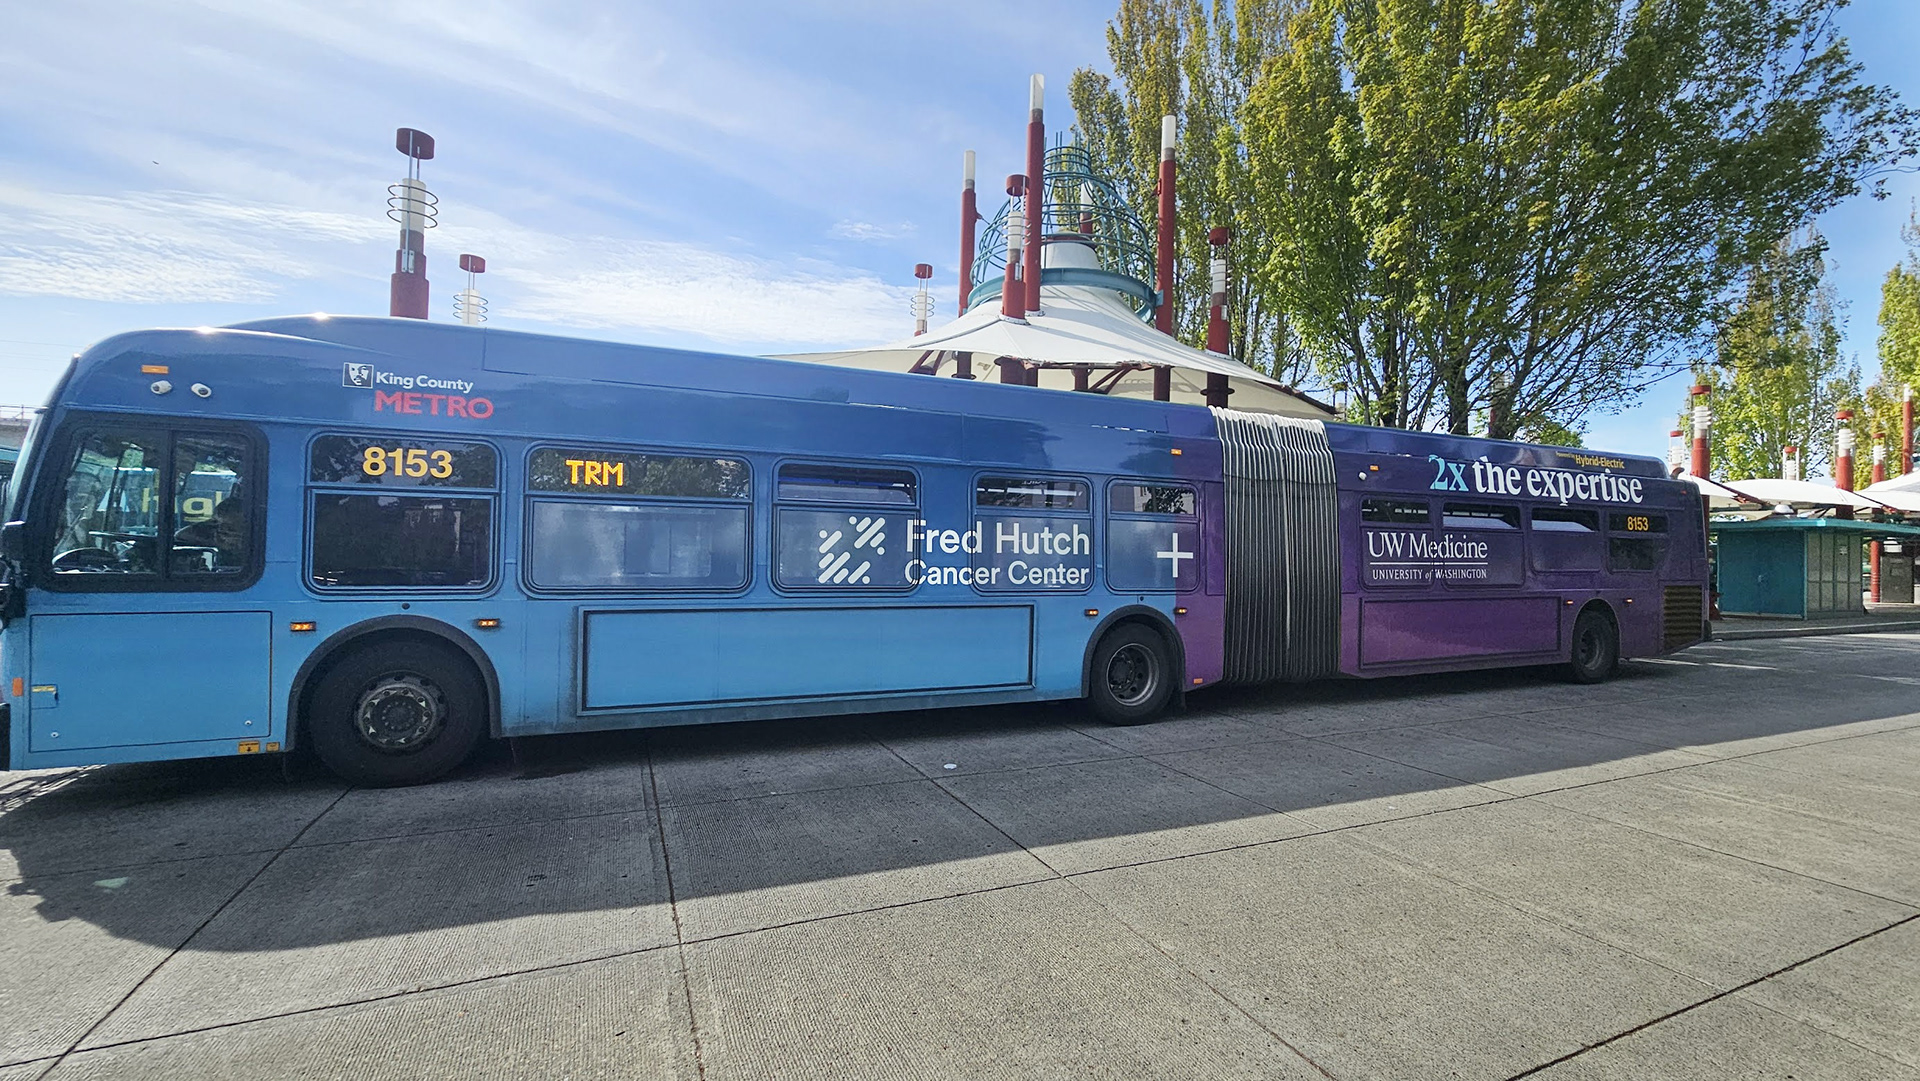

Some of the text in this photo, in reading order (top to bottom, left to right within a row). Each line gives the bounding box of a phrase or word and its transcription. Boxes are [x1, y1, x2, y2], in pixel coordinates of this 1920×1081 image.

[376, 371, 474, 393] King County
[374, 390, 494, 419] METRO
[362, 446, 453, 478] 8153
[565, 459, 624, 486] TRM
[1575, 454, 1625, 469] Hybrid-Electric
[1428, 454, 1643, 506] 2x the expertise
[906, 519, 1091, 555] Fred Hutch
[1627, 516, 1649, 531] 8153
[1367, 531, 1488, 559] UW Medicine
[904, 559, 1090, 585] Cancer Center
[1372, 568, 1487, 582] UNIVERSITY of WASHINGTON
